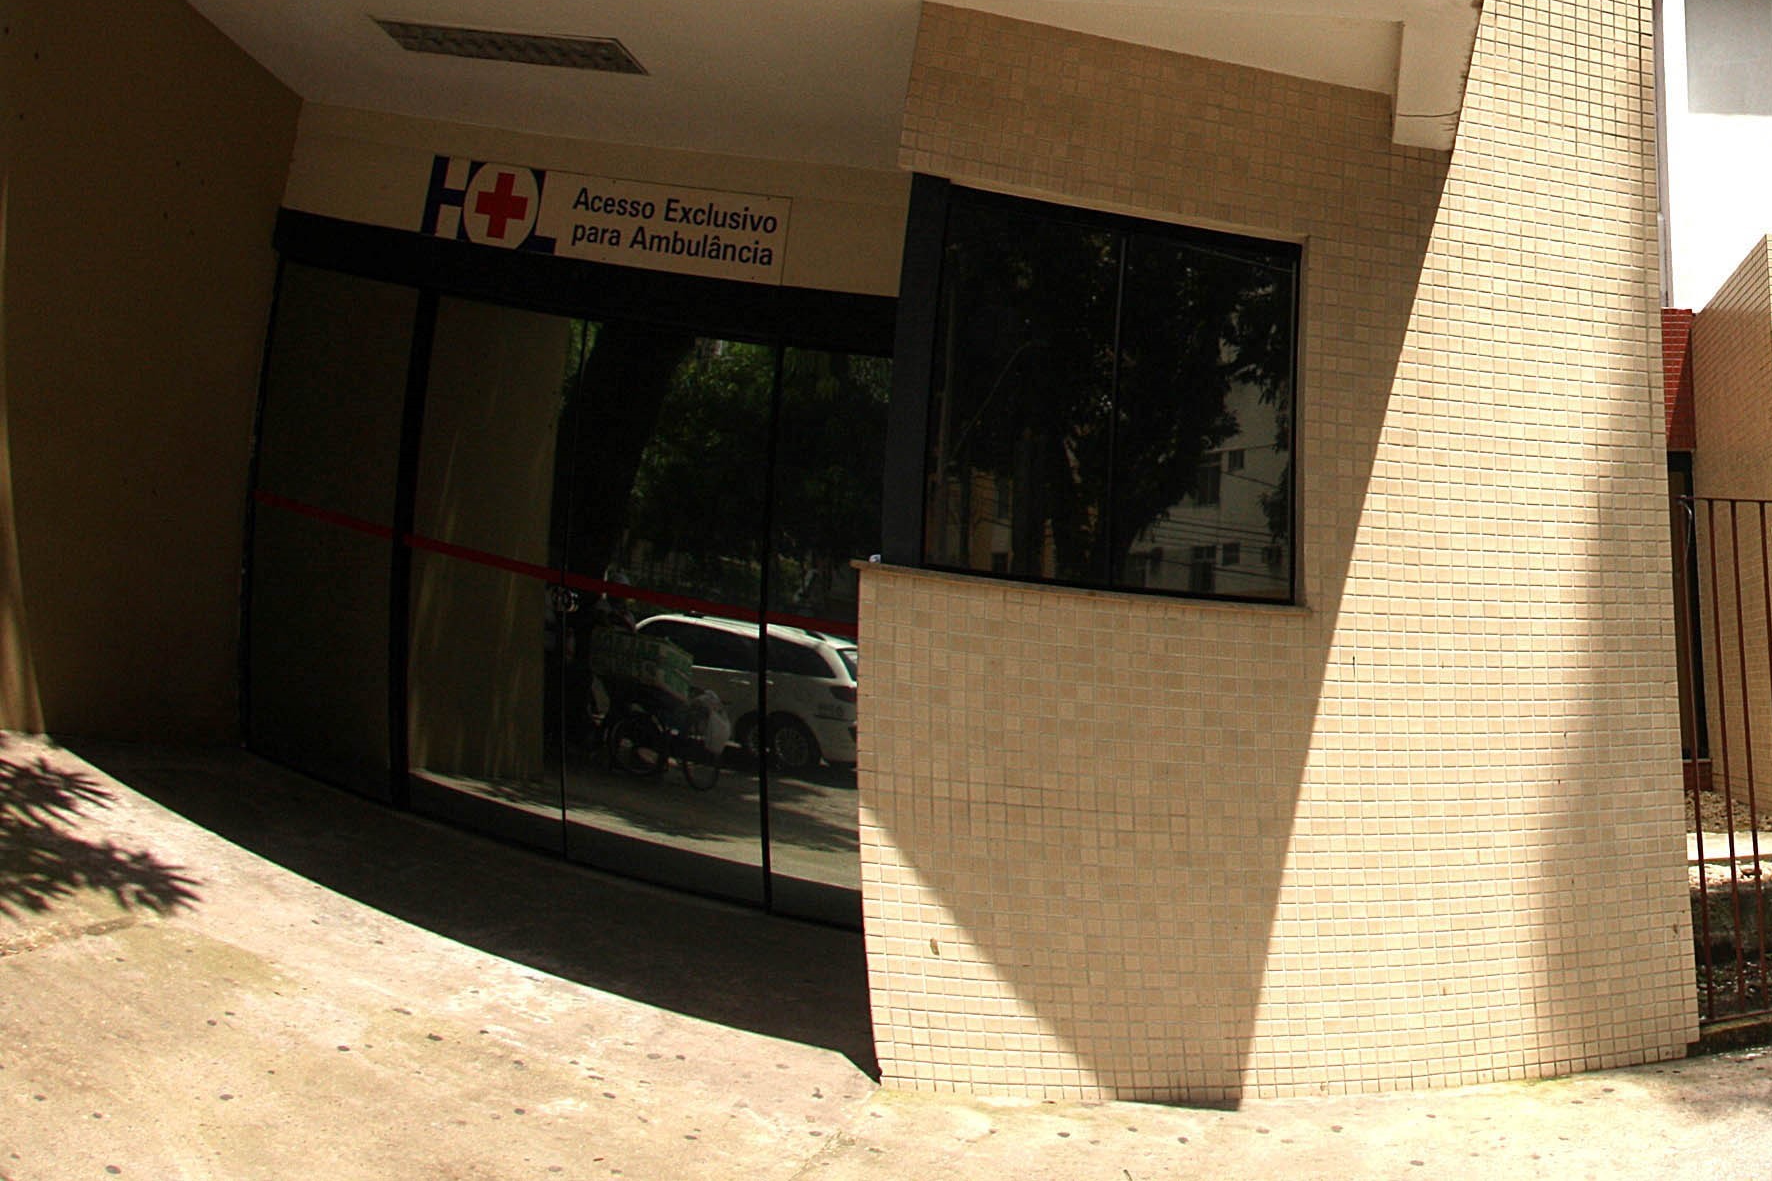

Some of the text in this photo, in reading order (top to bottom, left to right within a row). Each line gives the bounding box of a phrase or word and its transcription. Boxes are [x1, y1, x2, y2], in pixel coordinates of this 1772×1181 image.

[572, 186, 778, 235] Acesso Exclusivo
[571, 220, 774, 268] para Ambulância
